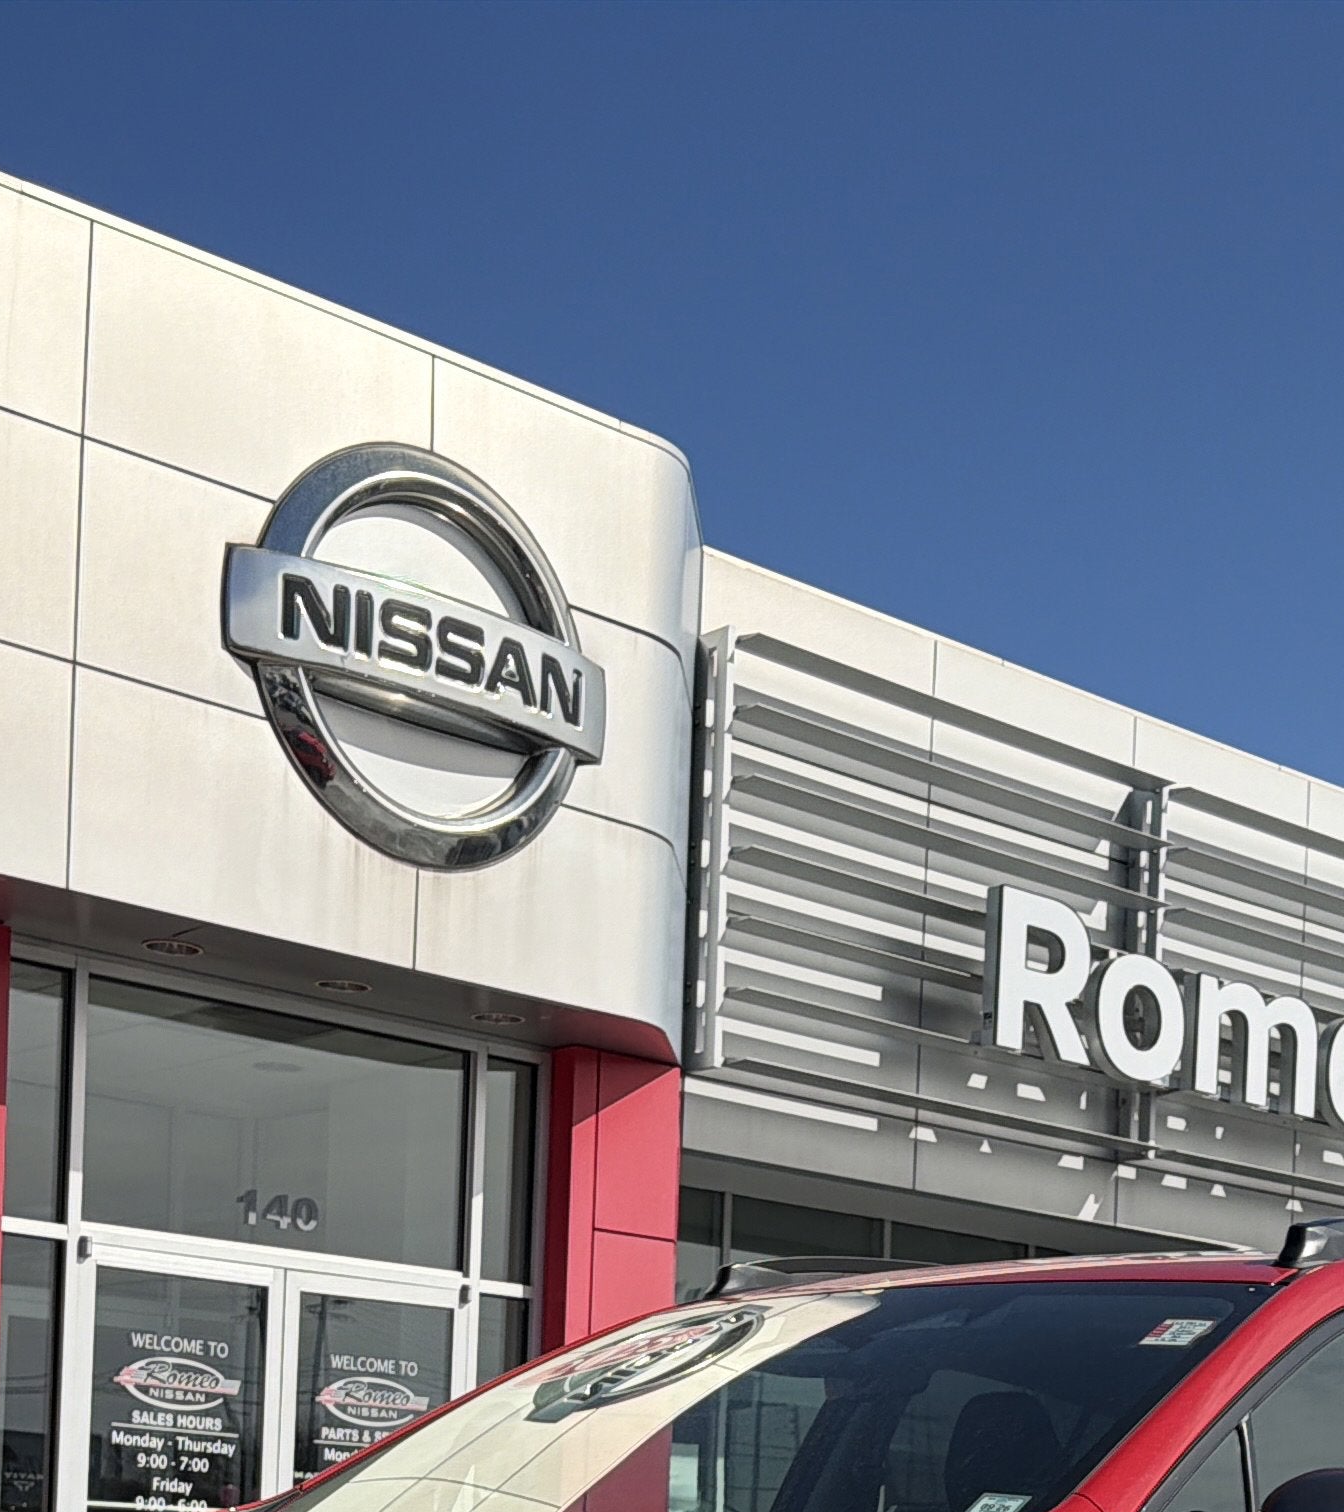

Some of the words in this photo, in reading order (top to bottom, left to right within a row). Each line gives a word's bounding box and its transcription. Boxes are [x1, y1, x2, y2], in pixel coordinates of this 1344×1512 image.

[278, 573, 585, 732] NISSAN
[236, 1189, 318, 1232] 140
[131, 1332, 204, 1355] WELCOME
[208, 1341, 229, 1358] TO
[143, 1361, 220, 1389] Romeo
[330, 1354, 395, 1374] WELCOME
[399, 1360, 418, 1376] TO
[149, 1388, 205, 1402] NISSAN
[337, 1381, 410, 1406] Romeo
[131, 1410, 173, 1427] SALES
[177, 1413, 222, 1431] HOURS
[347, 1406, 398, 1419] NISSAN
[111, 1430, 164, 1450] Monday
[176, 1436, 236, 1458] Thursday
[321, 1426, 359, 1442] PARTS
[362, 1430, 371, 1443] &
[137, 1453, 167, 1469] 9:00
[179, 1457, 209, 1473] 7:00
[152, 1477, 193, 1496] Friday
[135, 1496, 166, 1512] 9:00
